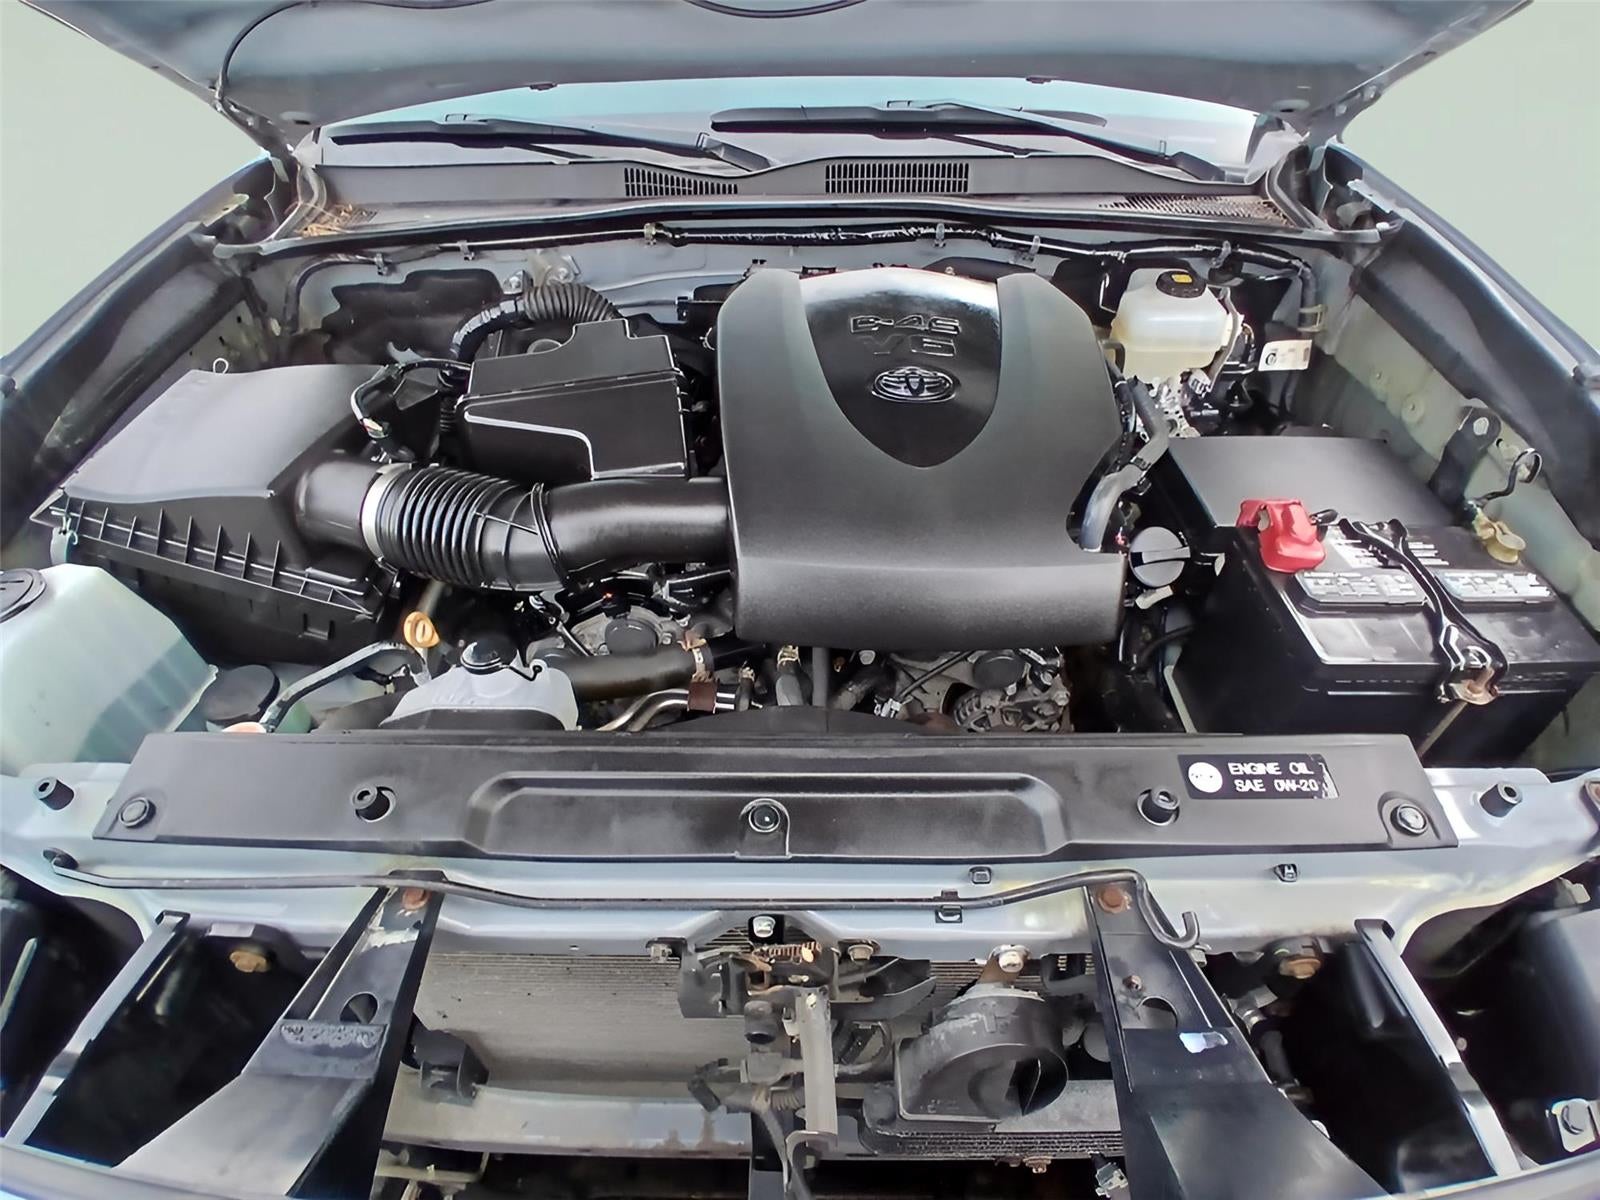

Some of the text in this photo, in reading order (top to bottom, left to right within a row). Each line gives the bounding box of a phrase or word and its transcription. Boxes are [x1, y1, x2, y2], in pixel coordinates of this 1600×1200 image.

[1227, 762, 1315, 775] ENGINE OIL
[1233, 779, 1320, 792] SAE 0W-20
